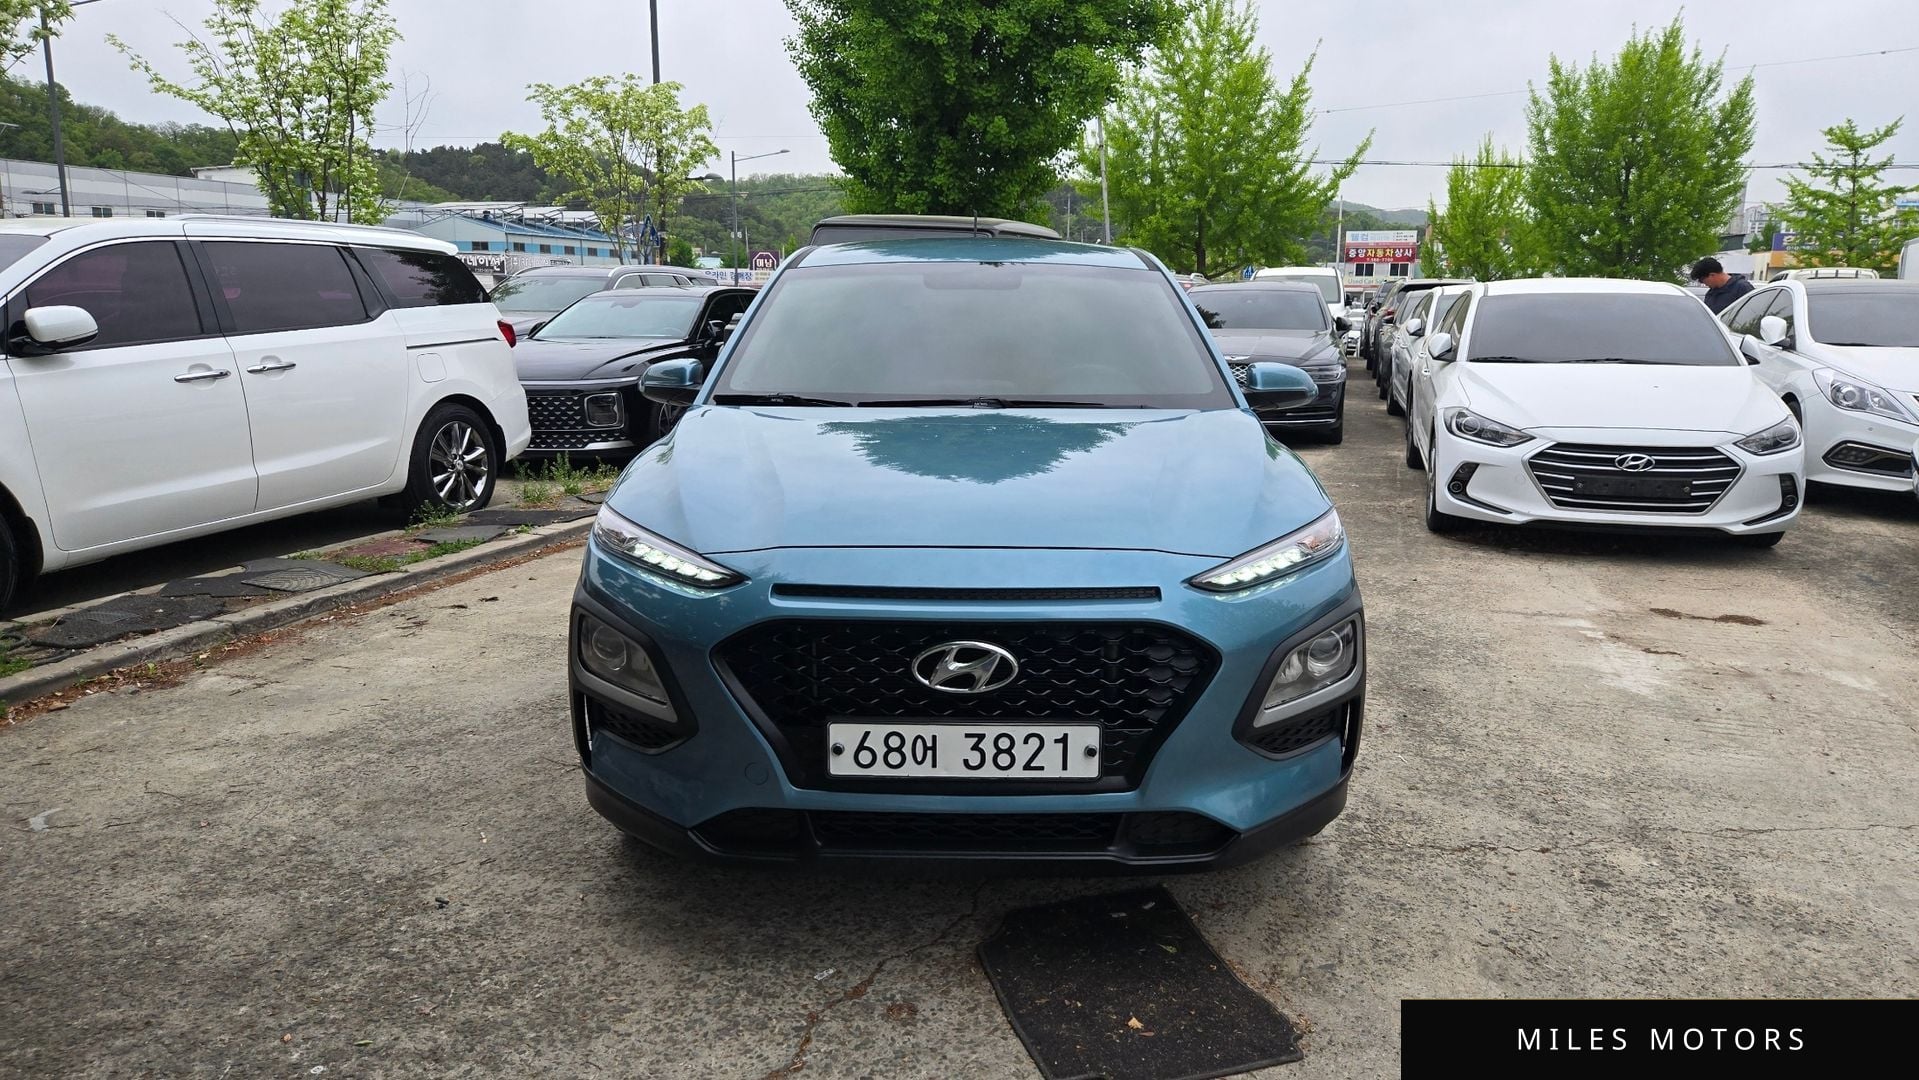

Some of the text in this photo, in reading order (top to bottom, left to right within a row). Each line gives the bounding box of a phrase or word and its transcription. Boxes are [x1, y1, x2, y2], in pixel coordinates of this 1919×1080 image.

[1349, 248, 1412, 257] 중앙자동차상사
[853, 730, 1069, 772] 68어 3821
